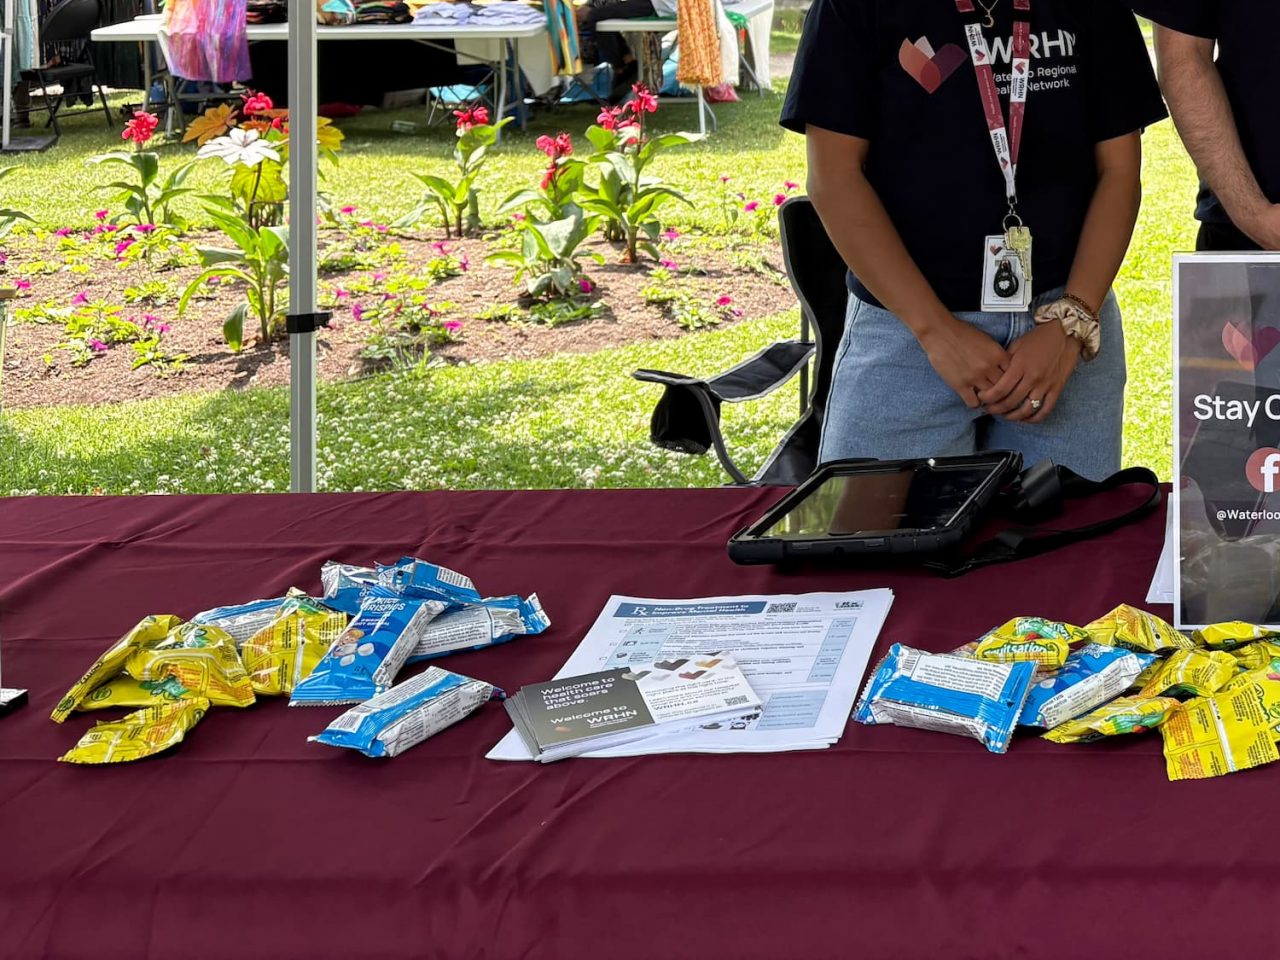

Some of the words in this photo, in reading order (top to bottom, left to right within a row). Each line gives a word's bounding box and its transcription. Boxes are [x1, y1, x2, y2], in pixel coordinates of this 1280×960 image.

[1037, 65, 1077, 78] Regional
[1193, 394, 1261, 428] Stay
[541, 679, 600, 695] Welcome
[543, 687, 583, 700] health
[585, 683, 614, 692] care
[545, 695, 574, 705] that
[574, 689, 609, 699] soars
[546, 699, 589, 710] above.
[551, 707, 611, 724] Welcome
[587, 709, 638, 724] WRHN
